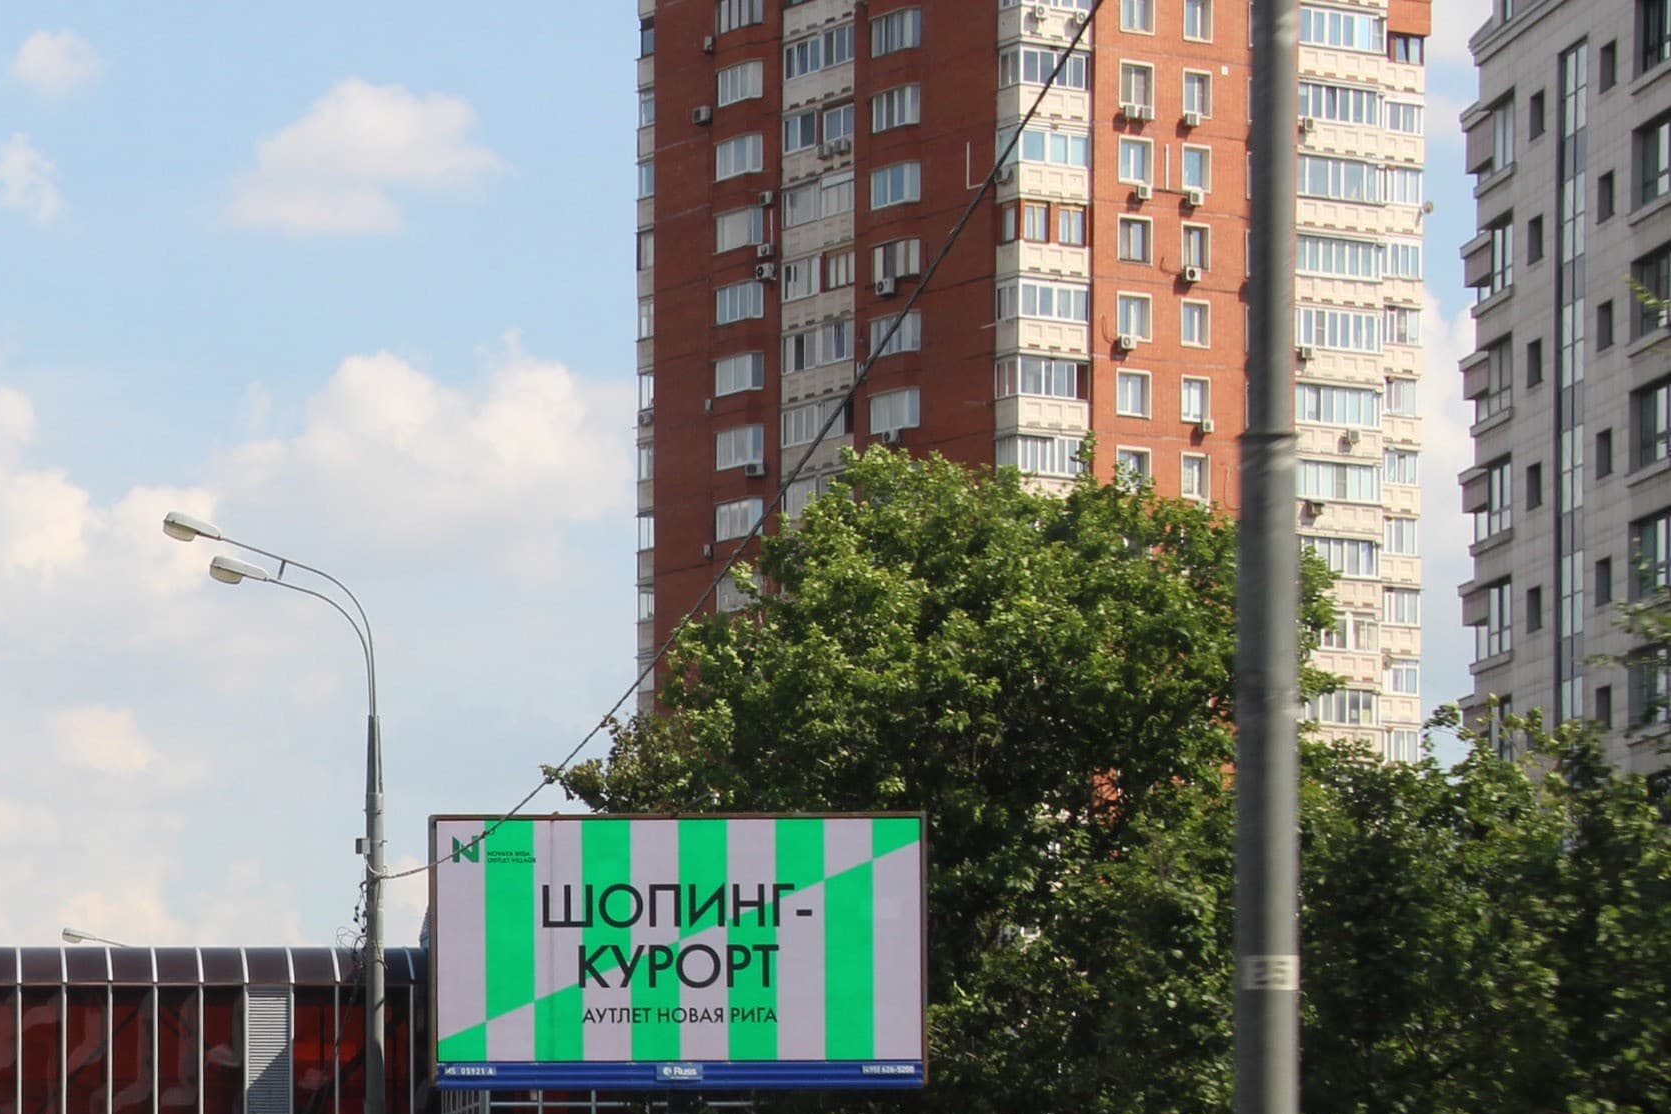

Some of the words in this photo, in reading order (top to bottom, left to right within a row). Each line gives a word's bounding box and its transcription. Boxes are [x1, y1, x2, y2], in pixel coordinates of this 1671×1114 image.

[542, 883, 813, 928] ШОПИНГ-
[578, 944, 779, 989] КУРОРТ
[582, 1007, 651, 1023] АУТЛЕТ
[657, 1007, 724, 1023] НОВАЯ
[730, 1007, 778, 1023] РИГА
